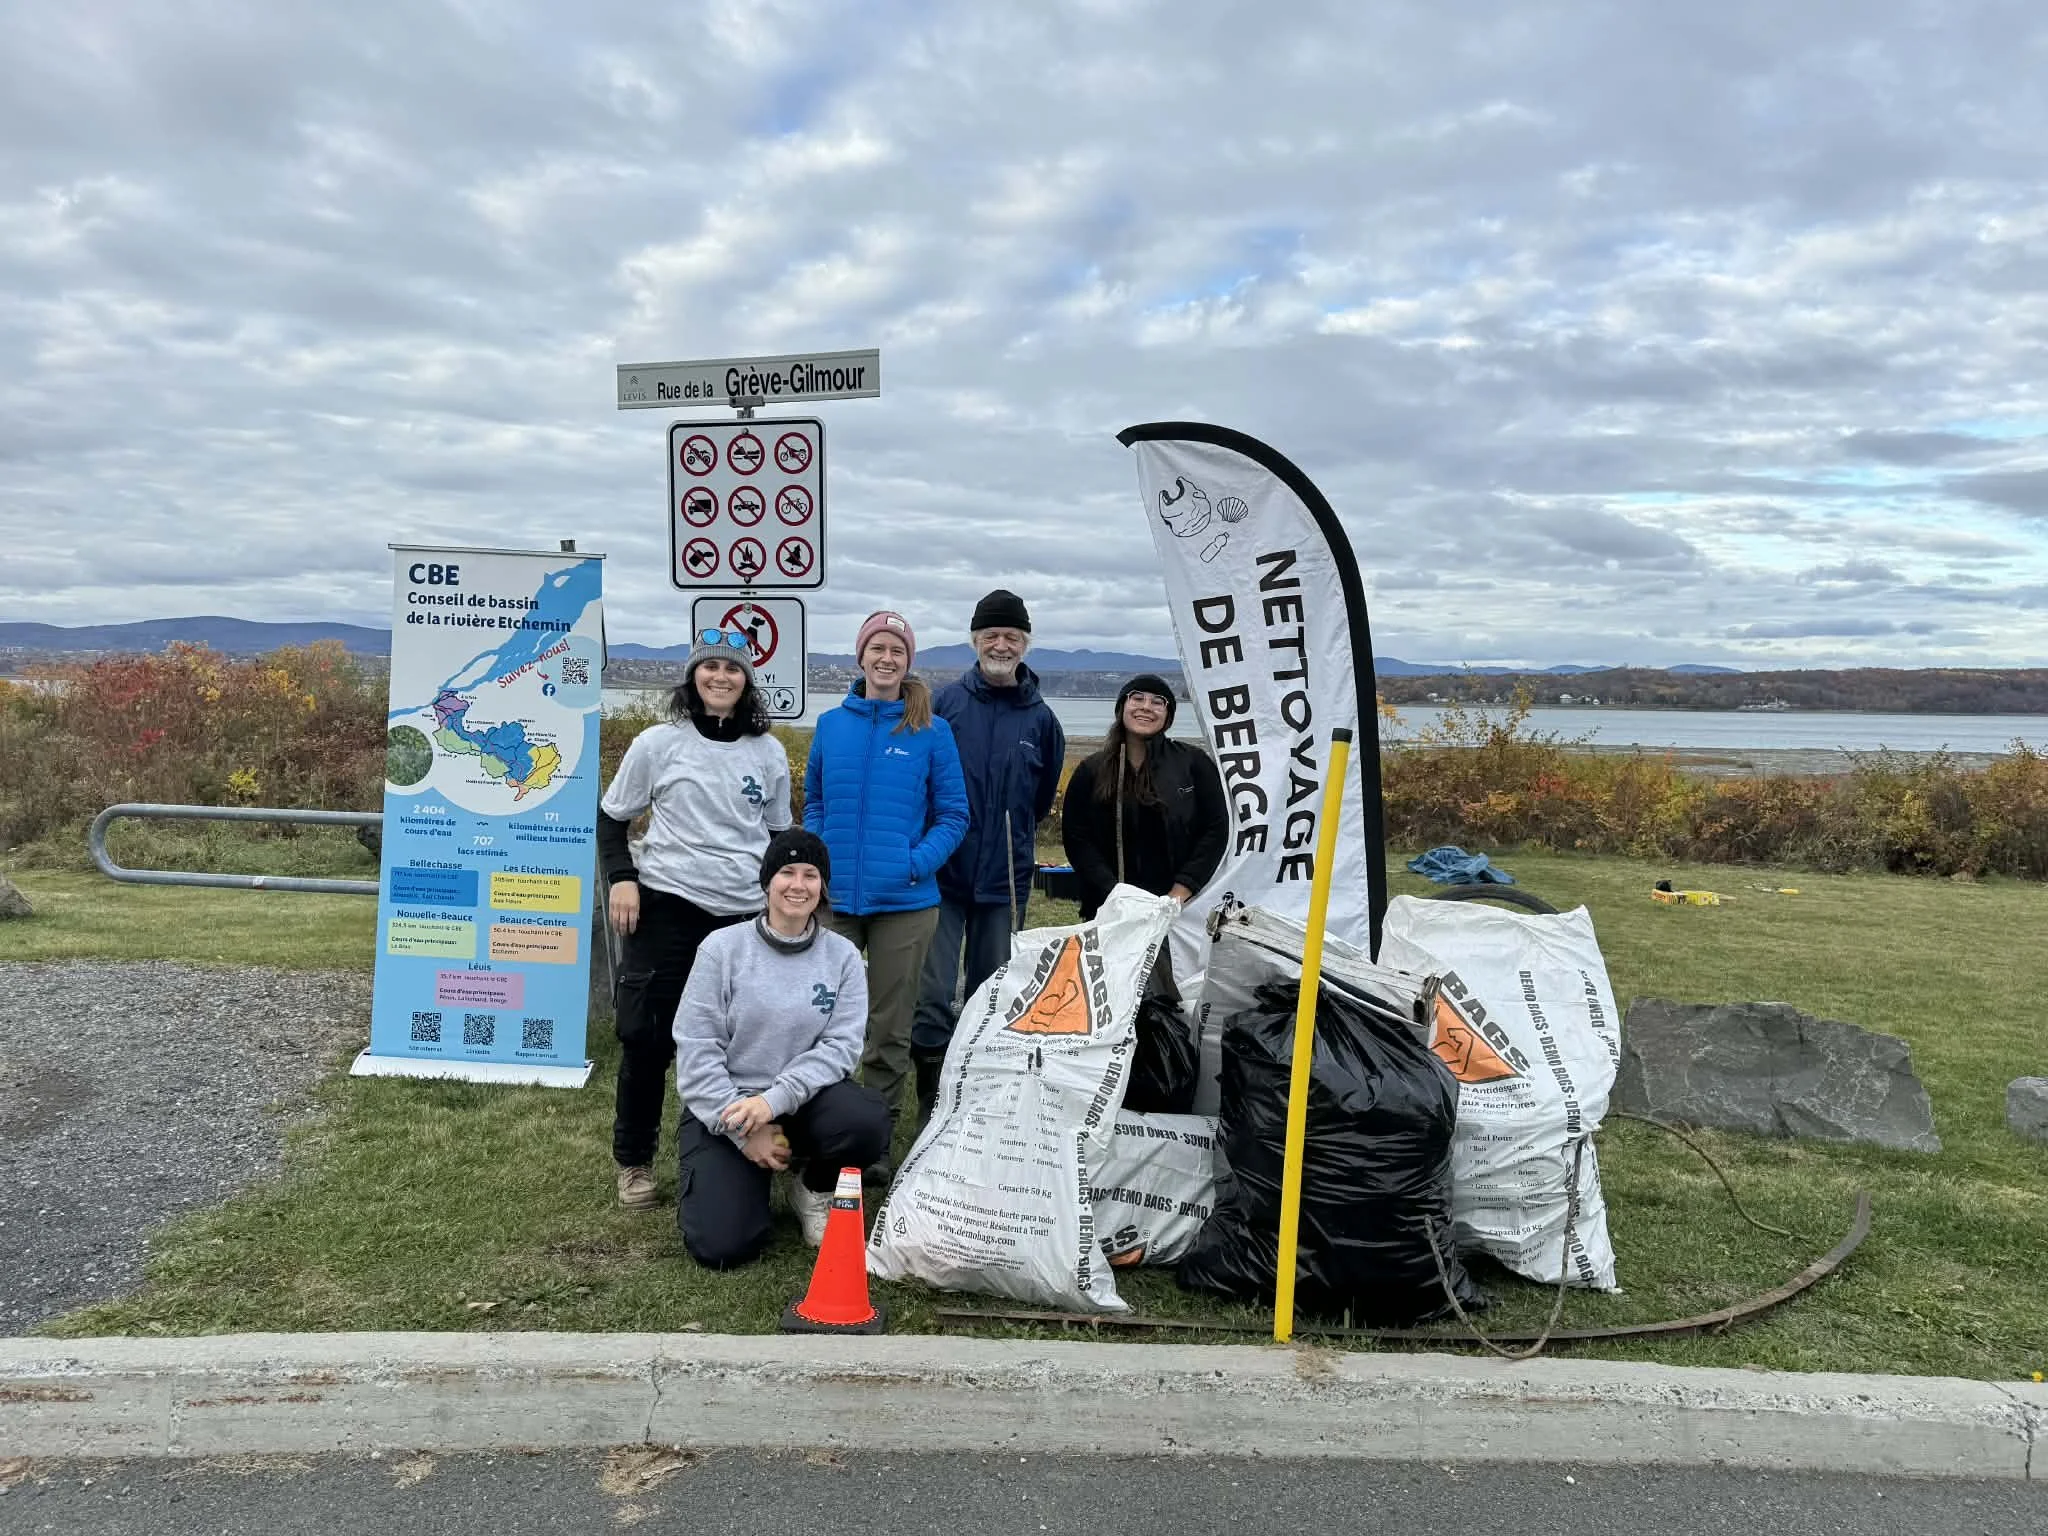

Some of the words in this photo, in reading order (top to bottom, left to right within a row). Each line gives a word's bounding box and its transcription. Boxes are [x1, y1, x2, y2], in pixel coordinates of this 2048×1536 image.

[657, 382, 681, 400] Rue
[684, 381, 699, 399] de
[703, 380, 713, 398] la
[725, 363, 865, 397] Grève-Gilmour
[408, 563, 460, 586] CBE
[407, 591, 464, 606] Conseil
[467, 594, 485, 608] de
[488, 595, 539, 610] bassin
[406, 611, 423, 625] de
[427, 612, 441, 625] la
[444, 613, 496, 628] rivière
[499, 617, 571, 633] Etchemin
[1192, 594, 1244, 669] DE
[497, 638, 571, 689] Suivez-nous!
[1255, 549, 1314, 884] NETTOYAGE
[1207, 684, 1269, 857] BERGE
[445, 818, 457, 827] de
[544, 812, 559, 822] 171
[554, 825, 582, 834] carrés
[583, 826, 594, 834] de
[404, 828, 428, 836] cours
[429, 827, 452, 837] d'eau
[472, 836, 494, 847] 707
[515, 832, 548, 843] milieux
[549, 834, 587, 845] humides
[457, 846, 473, 856] lacs
[474, 847, 508, 857] estimés
[409, 859, 463, 870] Bellechasse
[503, 865, 518, 873] Les
[521, 865, 569, 876] Etchemins
[396, 909, 473, 922] Nouvelle-Beauce
[499, 915, 567, 927] Beauce-Centre
[468, 962, 492, 971] Lévis
[1083, 926, 1113, 1029] BAGS
[1518, 970, 1537, 1002] DEMO
[1441, 970, 1531, 1073] BAGS
[1527, 1002, 1549, 1031] BAGS
[1586, 998, 1605, 1028] DEMO
[1540, 1036, 1561, 1068] DEMO
[1101, 1062, 1123, 1096] DEMO
[1551, 1065, 1575, 1095] BAGS
[1084, 1094, 1108, 1129] BAGS
[1564, 1100, 1581, 1134] DEMO
[1114, 1123, 1145, 1138] BAGS
[998, 1183, 1030, 1194] Capacité
[1041, 1188, 1052, 1199] Kg
[1077, 1168, 1091, 1205] BAGS
[999, 1208, 1020, 1220] fuerte
[1020, 1212, 1038, 1223] para
[1112, 1187, 1143, 1206] DEMO
[1143, 1194, 1173, 1213] BAGS
[1179, 1204, 1208, 1221] DEMO
[937, 1222, 1016, 1247] www.demobags.com
[1029, 1226, 1049, 1237] Tout!
[1078, 1215, 1094, 1254] DEMO
[1077, 1255, 1092, 1292] BAGS
